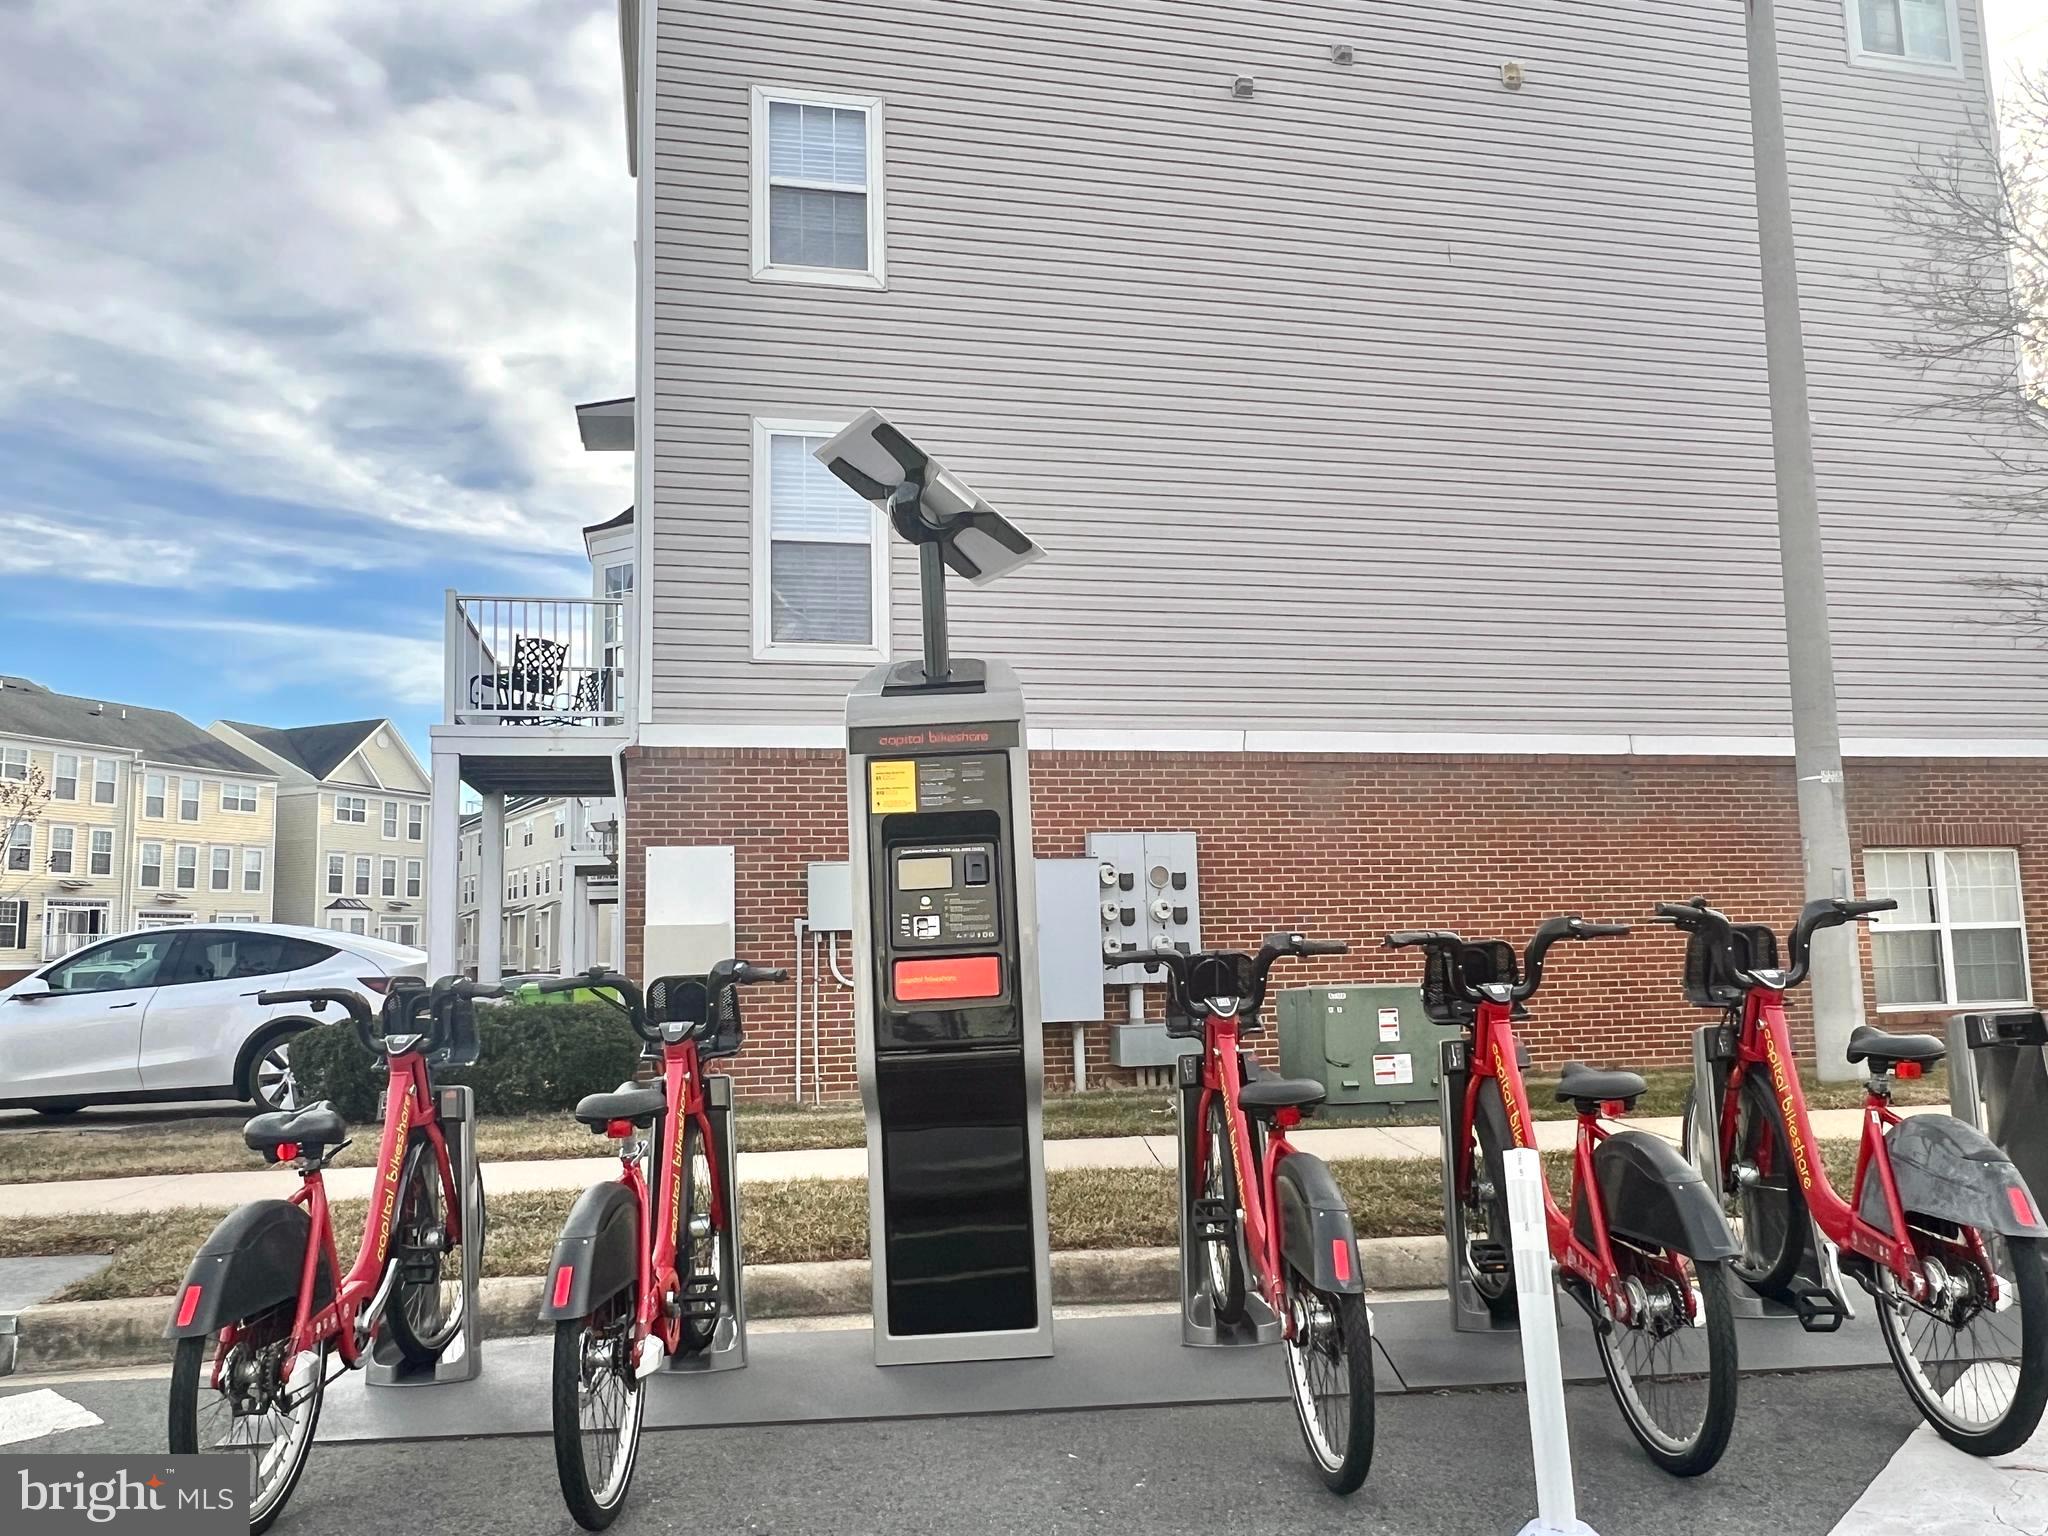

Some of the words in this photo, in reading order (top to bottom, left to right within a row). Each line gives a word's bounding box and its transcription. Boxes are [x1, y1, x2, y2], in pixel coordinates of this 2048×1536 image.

[1492, 1043, 1515, 1107] capital
[1764, 1028, 1788, 1093] capital
[1781, 1095, 1812, 1190] bikeshare
[377, 1188, 394, 1262] capital
[386, 1097, 411, 1183] bikeshare
